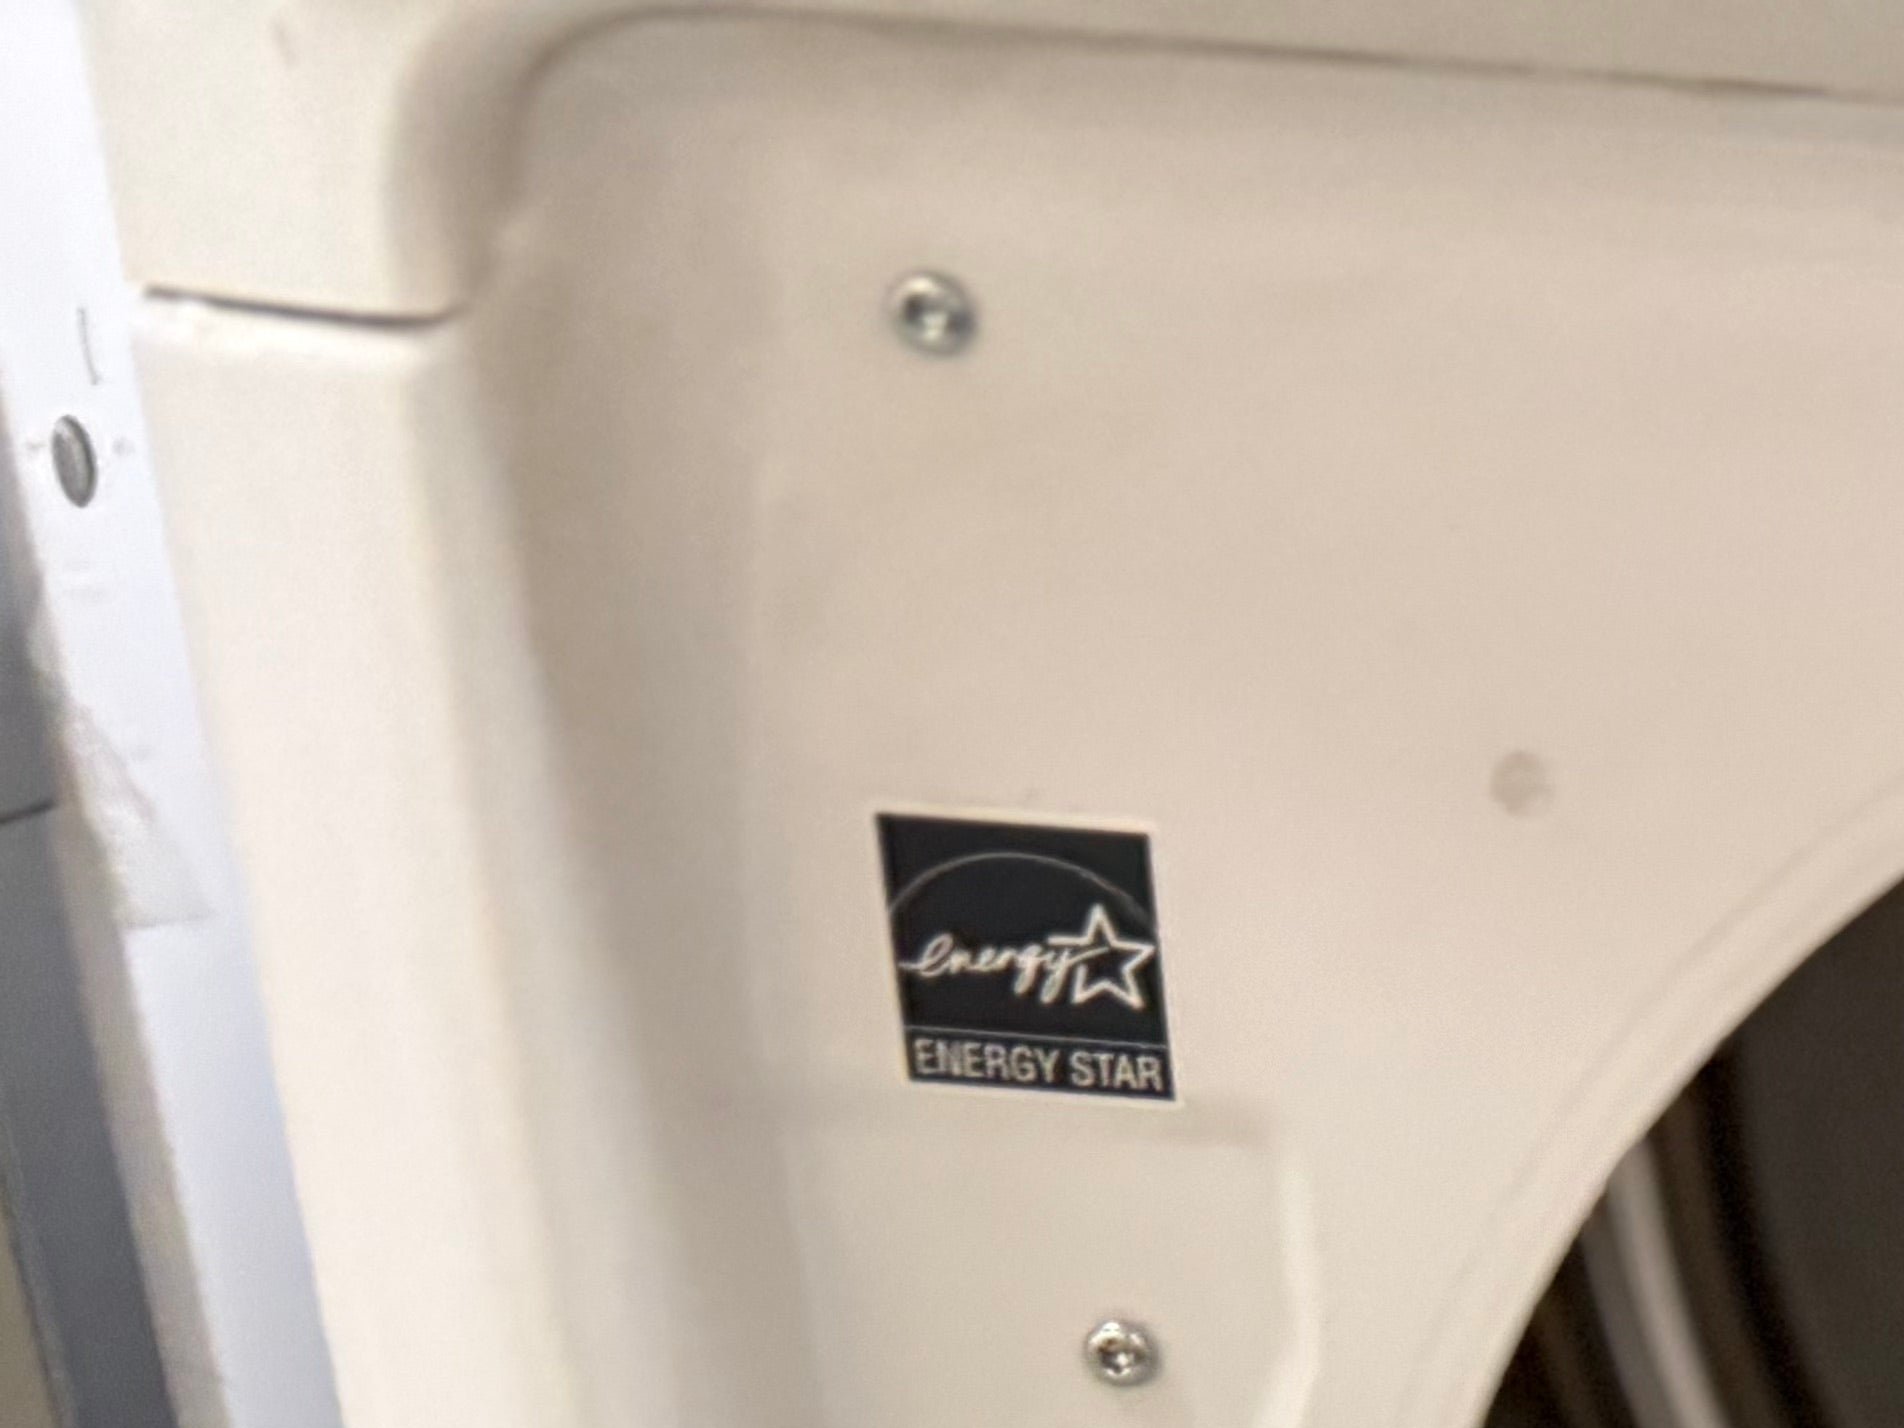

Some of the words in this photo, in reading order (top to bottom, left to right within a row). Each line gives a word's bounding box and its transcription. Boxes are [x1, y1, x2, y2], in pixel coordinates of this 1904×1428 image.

[899, 932, 1090, 1004] energy
[911, 1037, 1061, 1083] ENERGY
[1070, 1049, 1164, 1092] STAR
